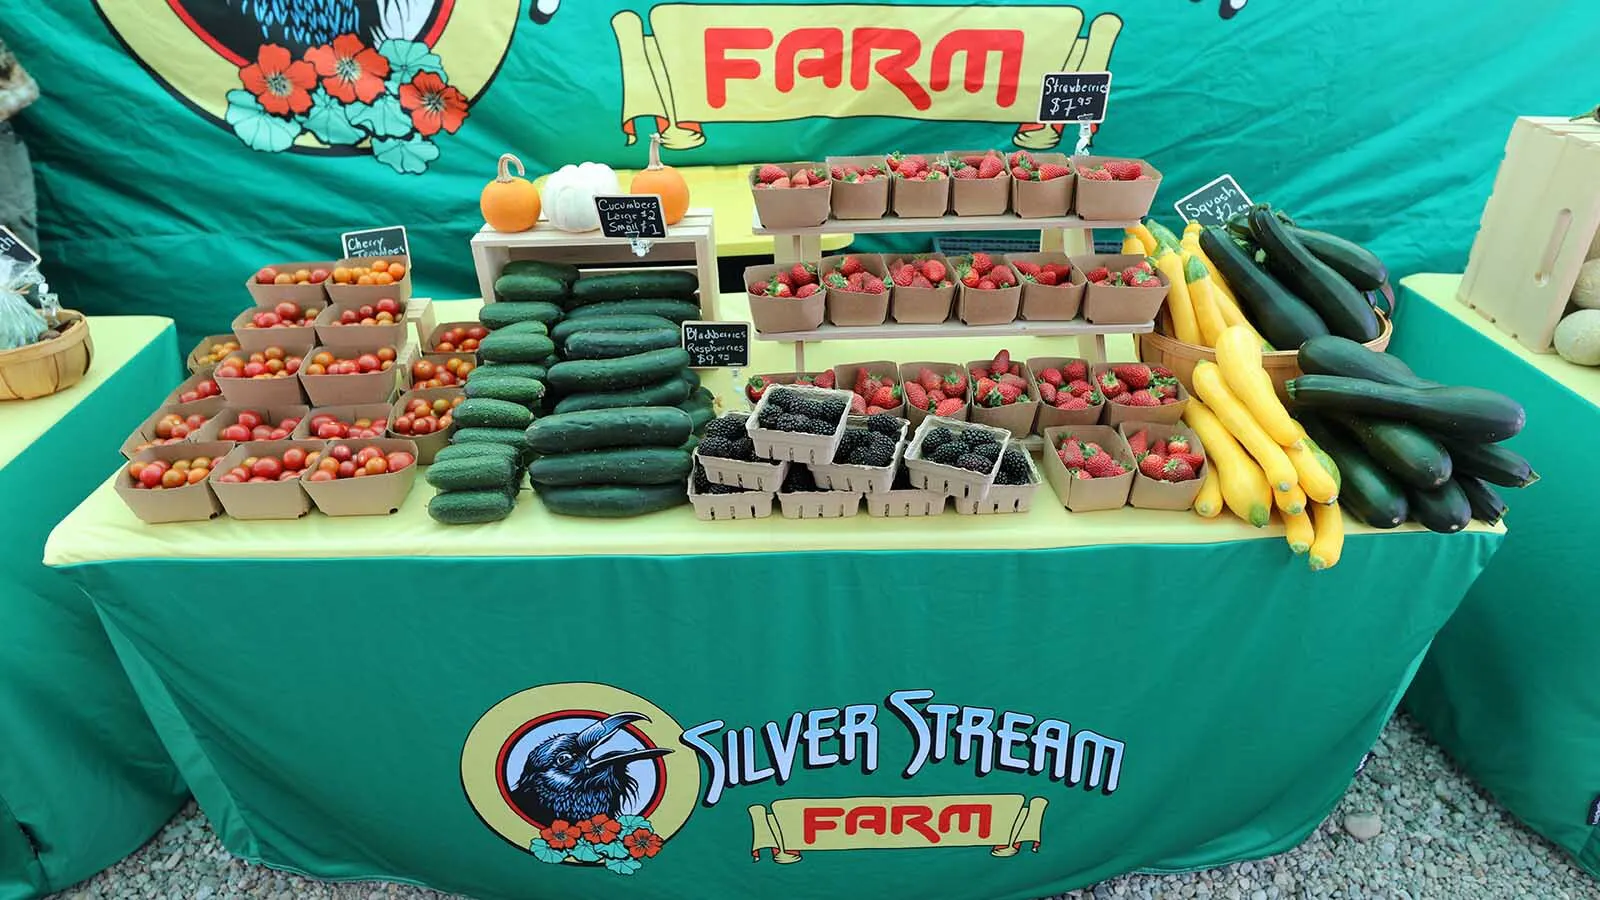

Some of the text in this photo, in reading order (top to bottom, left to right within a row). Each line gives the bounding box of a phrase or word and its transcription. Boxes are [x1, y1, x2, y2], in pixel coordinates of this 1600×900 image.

[704, 27, 1025, 111] FARM
[598, 199, 657, 211] Cucumbers
[607, 211, 638, 224] Large
[609, 221, 639, 233] Small
[347, 237, 384, 251] Cherry
[686, 327, 747, 341] Blackberries
[687, 343, 745, 354] Raspberries
[680, 689, 1126, 806] SILVER STREAM
[804, 804, 993, 844] FARM
